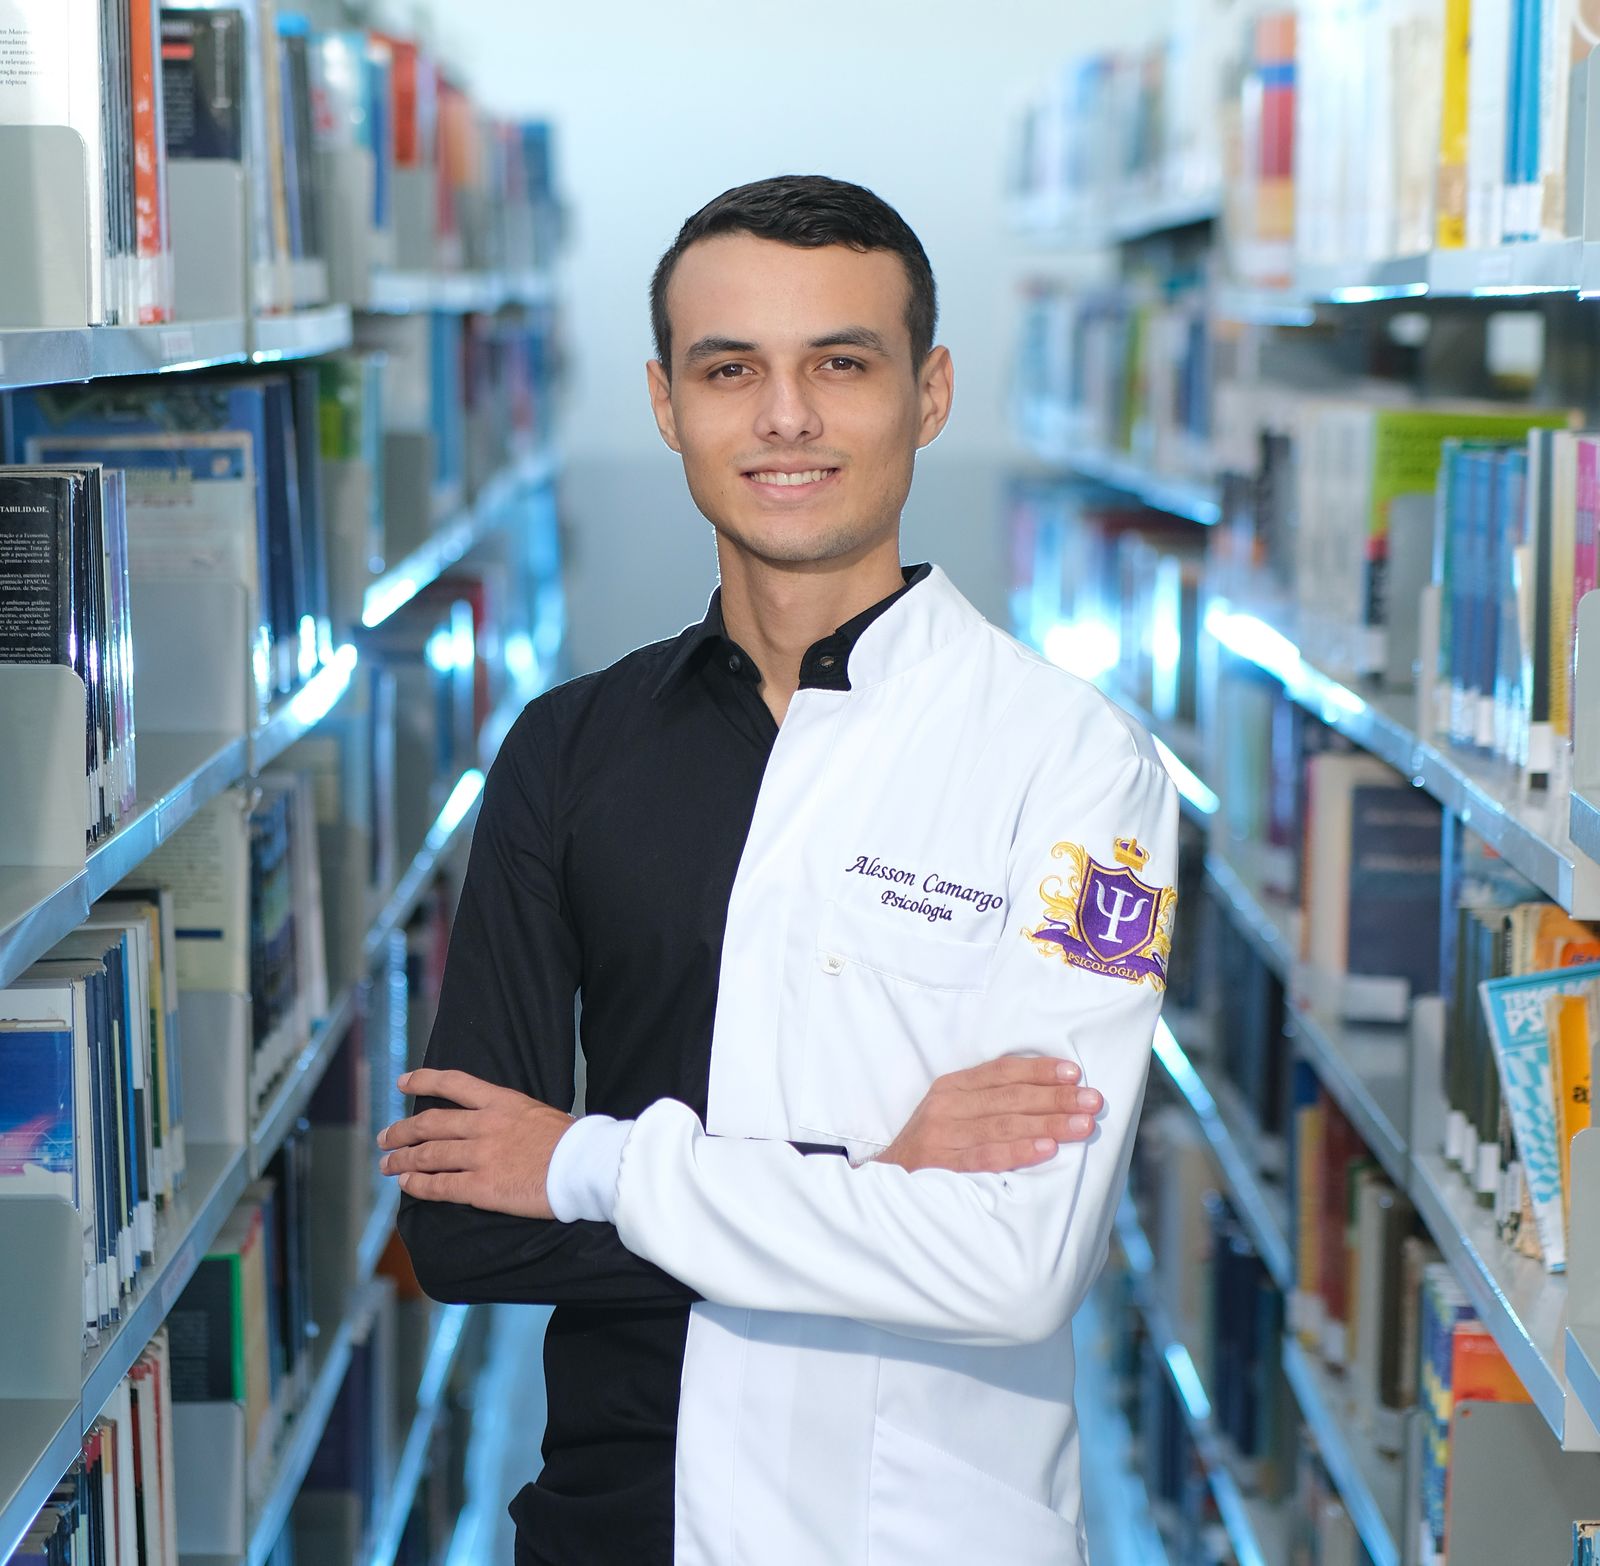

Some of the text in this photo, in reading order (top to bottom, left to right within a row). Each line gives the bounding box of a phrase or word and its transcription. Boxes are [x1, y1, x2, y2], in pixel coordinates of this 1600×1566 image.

[845, 855, 1003, 913] Alesson Camargo
[881, 890, 953, 922] Psicologia
[1067, 951, 1139, 979] PSICOLOGIA
